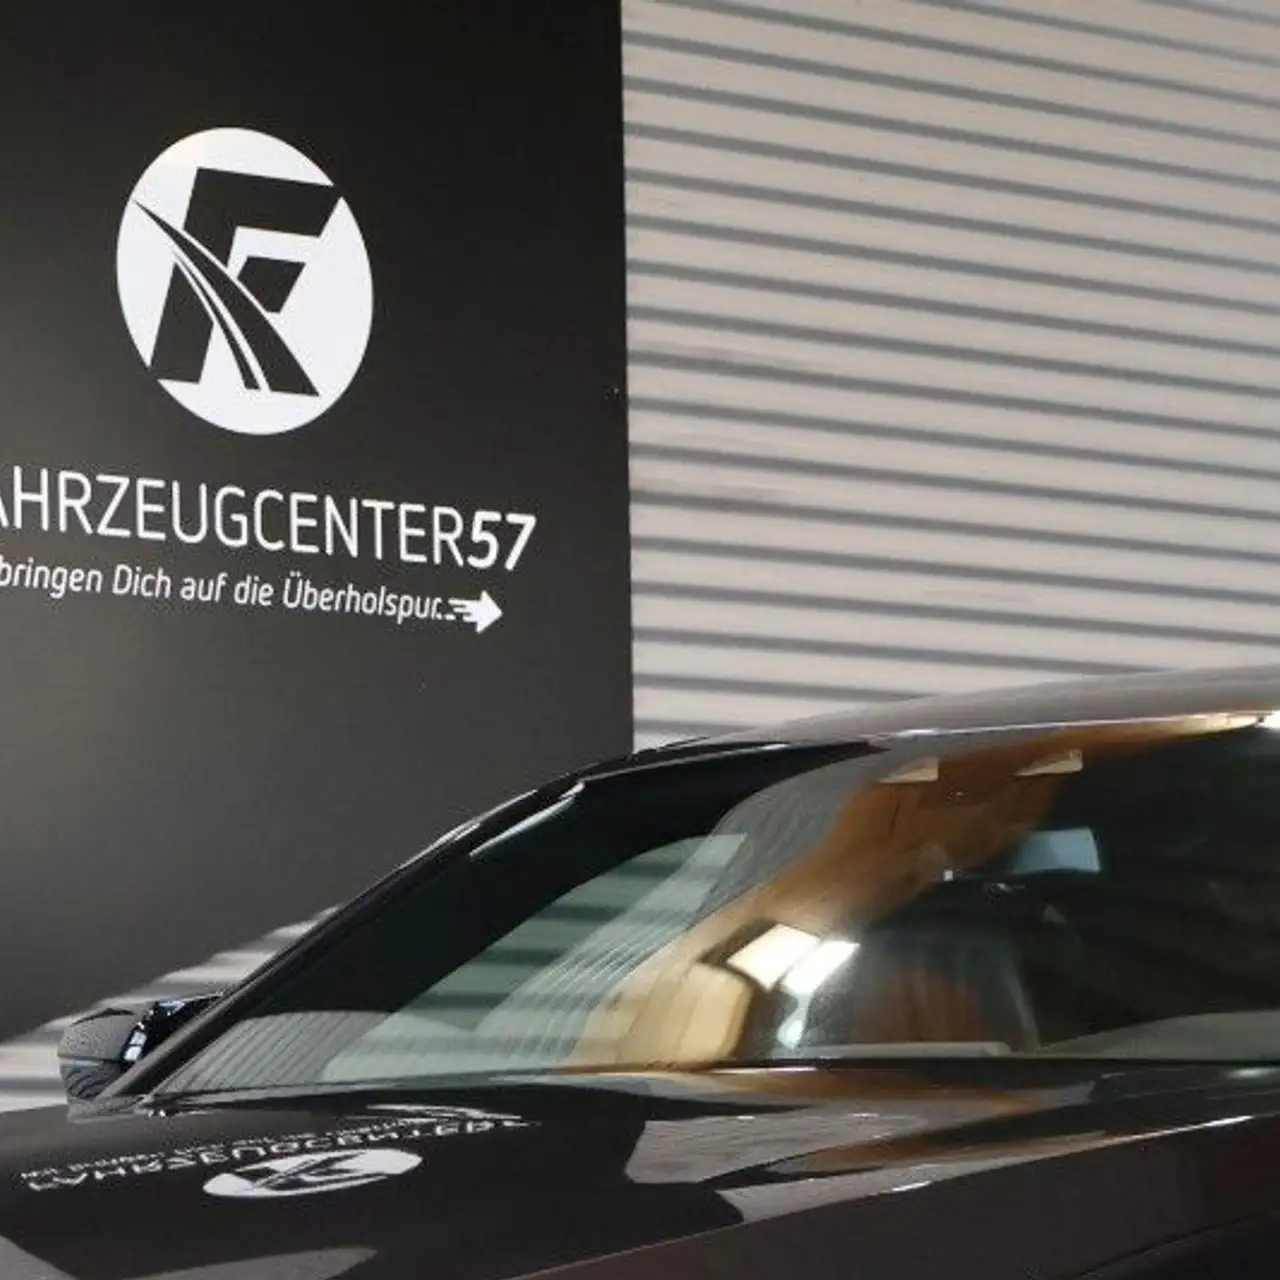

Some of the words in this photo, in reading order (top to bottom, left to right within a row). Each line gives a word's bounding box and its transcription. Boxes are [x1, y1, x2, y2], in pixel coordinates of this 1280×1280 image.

[112, 563, 171, 599] Dich
[180, 572, 230, 603] auf
[234, 574, 275, 607] die
